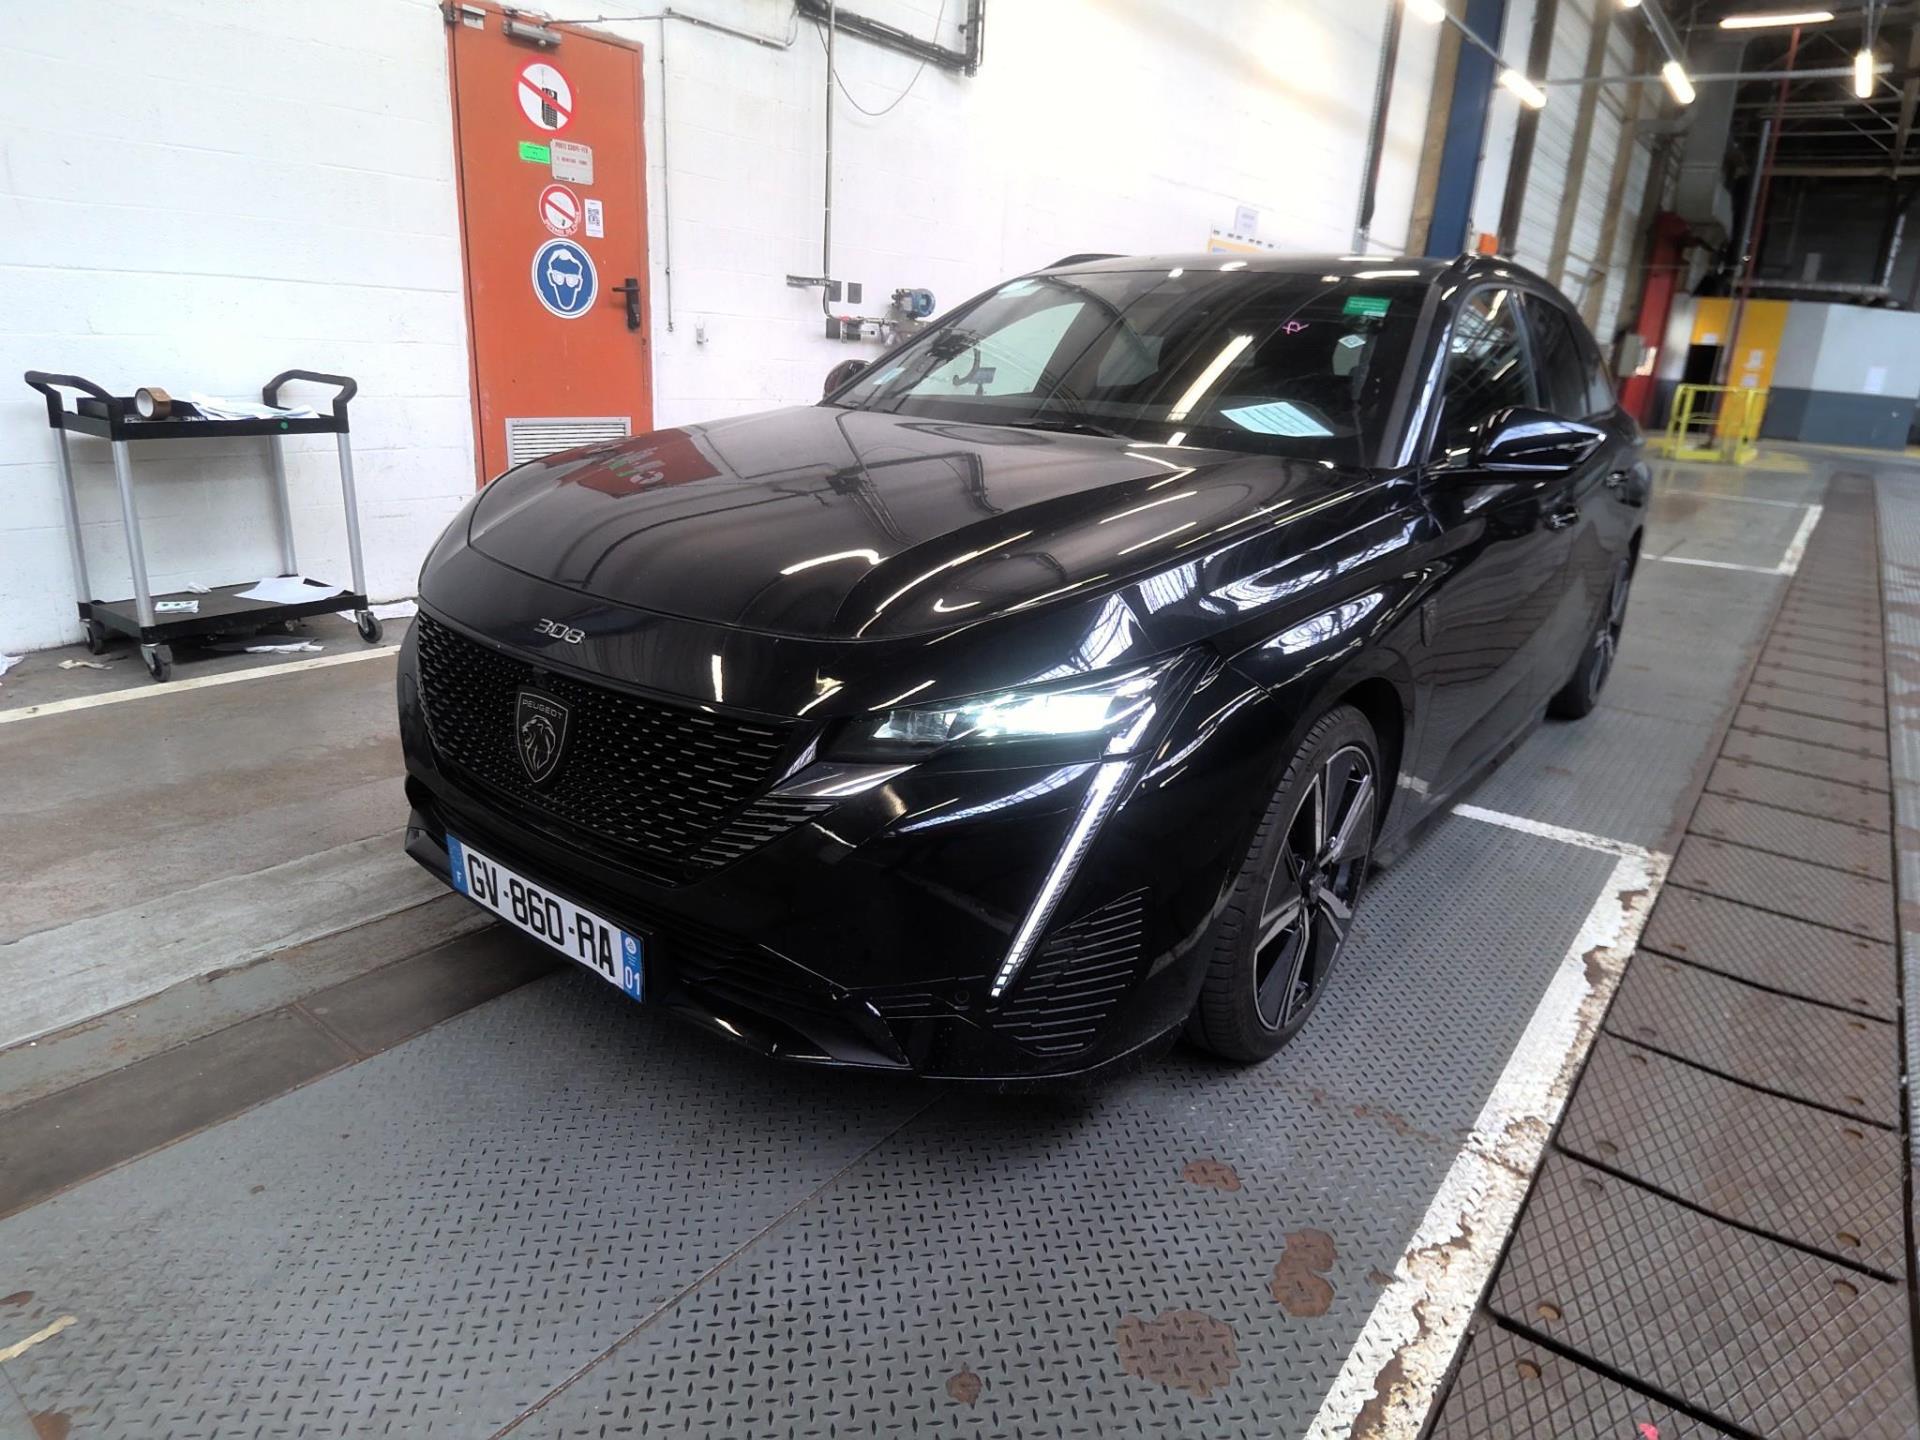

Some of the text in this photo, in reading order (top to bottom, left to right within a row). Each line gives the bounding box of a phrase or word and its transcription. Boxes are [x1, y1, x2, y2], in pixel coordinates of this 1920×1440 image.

[533, 618, 586, 644] 308
[522, 698, 563, 719] PEUGEOT
[467, 853, 616, 978] GV-860-RA
[624, 966, 641, 996] 01
